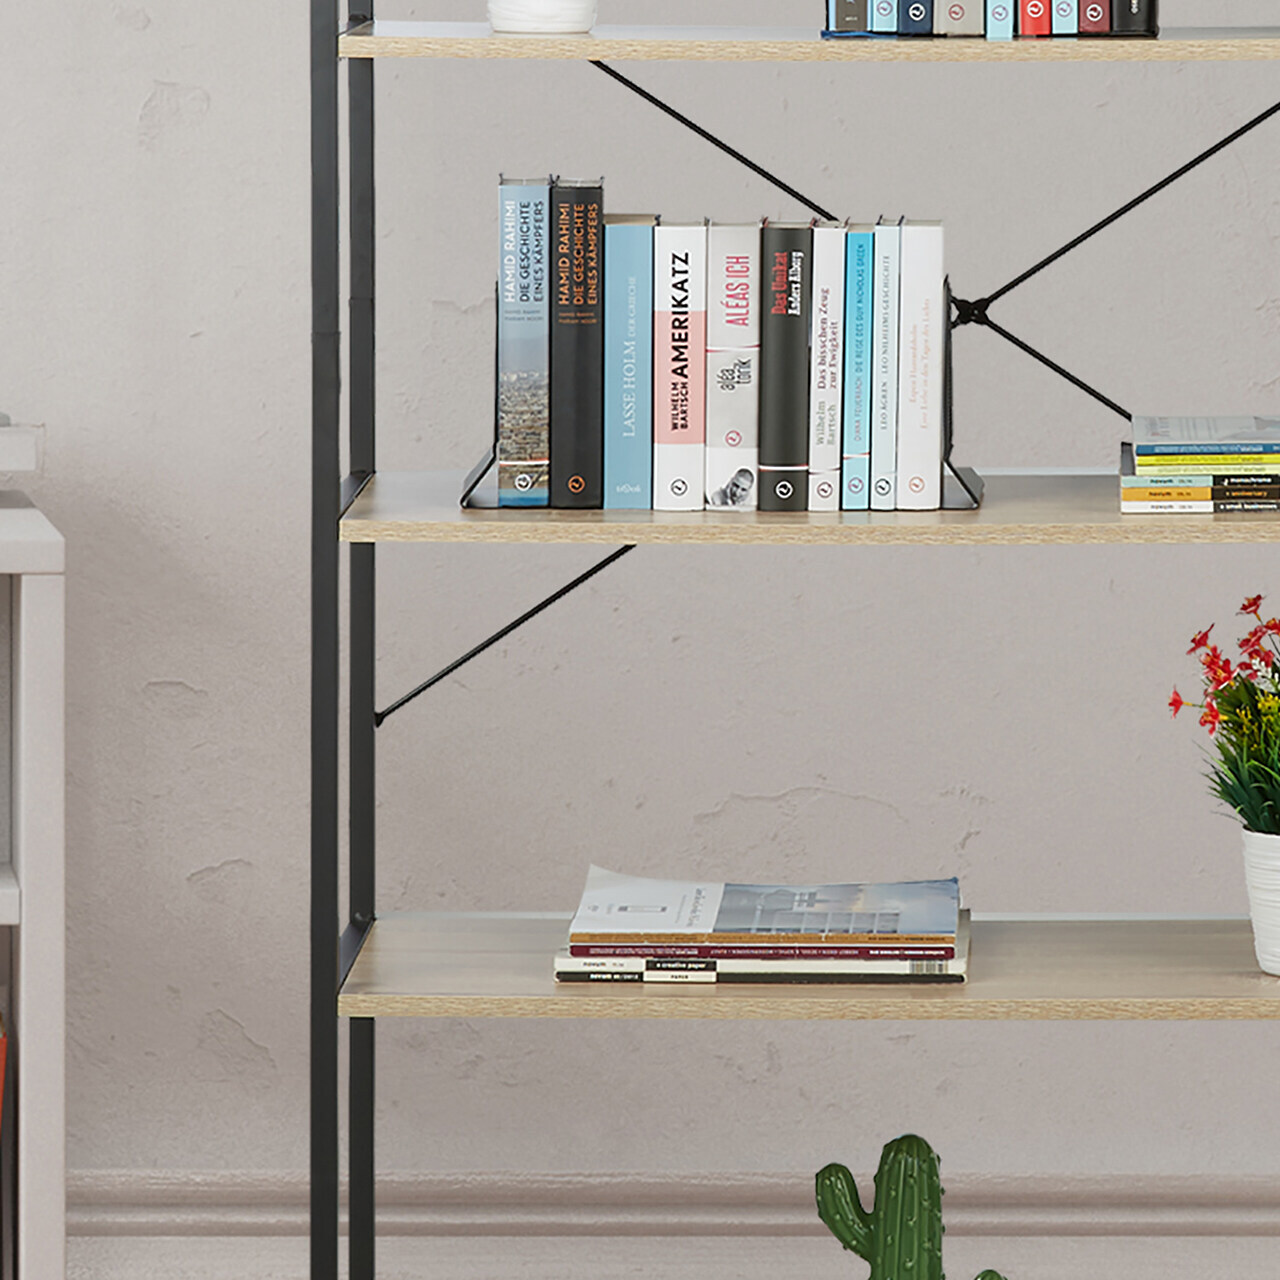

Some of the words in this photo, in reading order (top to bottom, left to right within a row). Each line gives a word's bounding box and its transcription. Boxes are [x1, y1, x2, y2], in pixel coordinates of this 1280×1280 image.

[504, 201, 516, 252] RAHIMI
[519, 201, 530, 281] GESCHICHTE
[532, 201, 544, 264] KÄMPFERS
[558, 204, 570, 253] RAHIMI
[573, 204, 584, 282] GESCHICHTE
[586, 204, 598, 267] KÄMPFERS
[726, 256, 749, 278] ICH
[771, 252, 787, 291] Unikat
[789, 252, 804, 281] Alborg
[856, 244, 865, 266] GREEN
[504, 256, 516, 303] HAMID
[519, 283, 530, 302] DIE
[533, 267, 544, 302] EINES
[558, 258, 570, 304] HAMID
[573, 285, 584, 304] DIE
[588, 270, 598, 304] EINES
[788, 284, 801, 315] Anders
[856, 269, 865, 304] NICHOLAS
[672, 252, 689, 379] AMERIKATZ
[720, 282, 749, 326] ALÉAS
[771, 294, 787, 315] Das
[819, 288, 830, 315] Zeug
[856, 306, 864, 320] GUY
[818, 318, 828, 367] bisschen
[828, 322, 839, 368] Ewigkeit
[855, 323, 864, 336] DES
[623, 341, 636, 389] HOLM
[717, 370, 736, 391] aléa
[817, 370, 826, 389] Das
[855, 361, 864, 373] DIE
[623, 392, 636, 437] LASSE
[671, 382, 679, 431] WILHELM
[680, 382, 688, 430] BARTSCH
[816, 401, 825, 445] Wilhelm
[827, 405, 836, 445] Bartsch
